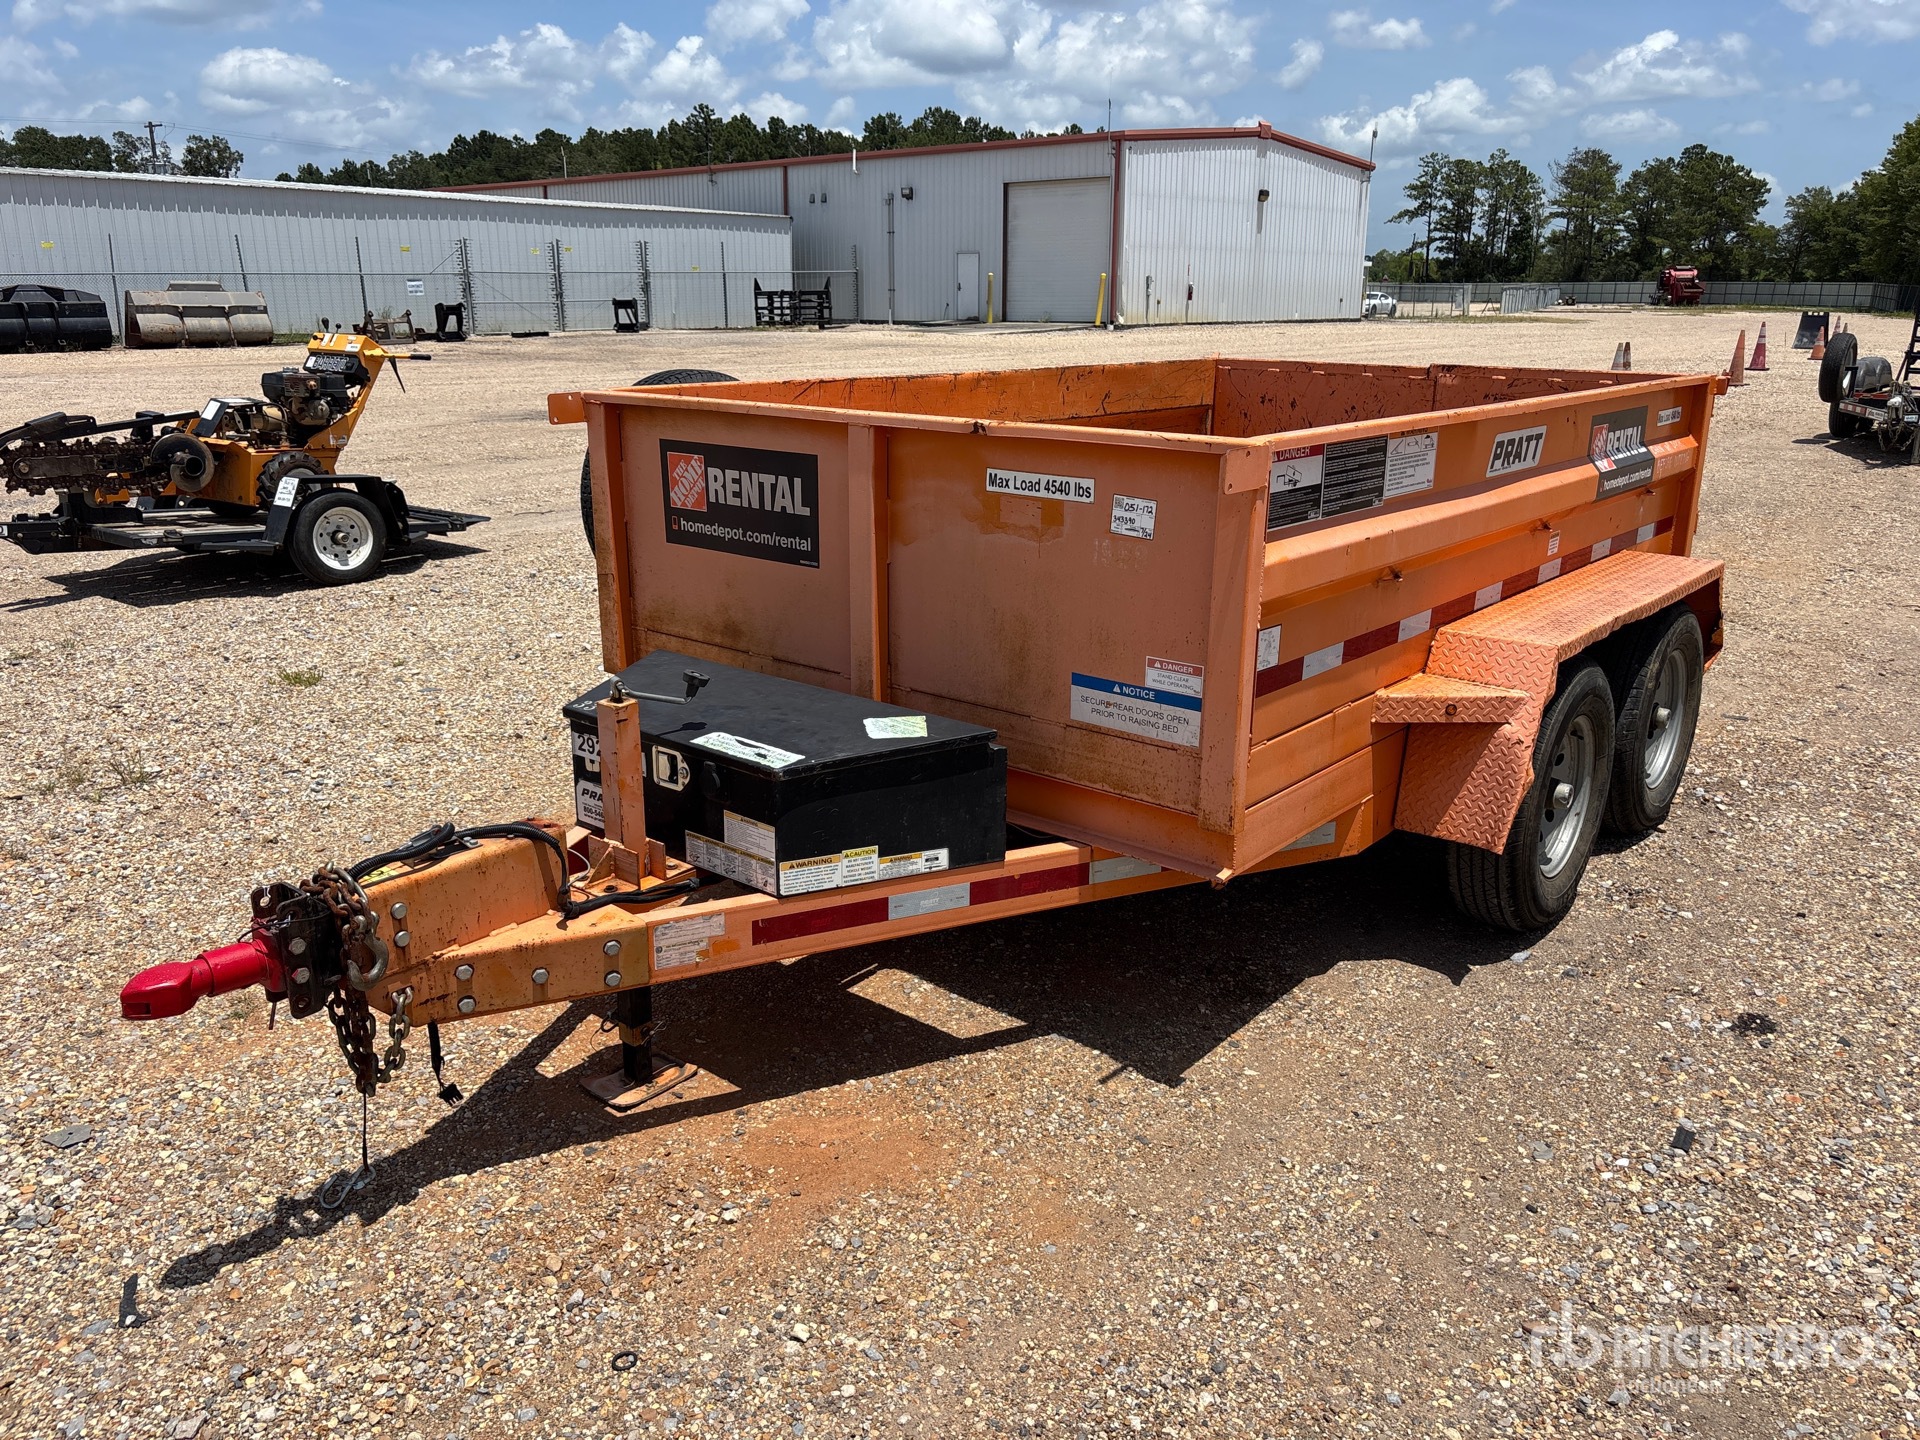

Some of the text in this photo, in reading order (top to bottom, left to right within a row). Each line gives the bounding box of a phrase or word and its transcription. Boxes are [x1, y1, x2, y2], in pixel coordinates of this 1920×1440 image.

[1280, 446, 1310, 460] DANGER
[1490, 432, 1544, 469] PRATT
[1606, 426, 1648, 460] RENTAL
[670, 454, 704, 507] HOME
[672, 458, 688, 479] THE
[1604, 466, 1652, 491] homedepot.com/rental
[684, 476, 705, 508] DEPOT
[707, 466, 810, 516] RENTAL
[988, 472, 1092, 499] Max Load 4540 lbs
[680, 518, 811, 552] homedepot.com/rental
[1162, 662, 1194, 674] DANGER
[1122, 685, 1156, 700] NOTICE
[1152, 678, 1166, 686] WHILE
[1080, 695, 1190, 726] SECURE REAR DOORS OPEN
[1090, 708, 1179, 734] PRIOR TO RAISING BED
[796, 857, 832, 868] WARNING
[850, 848, 875, 858] CAUTION
